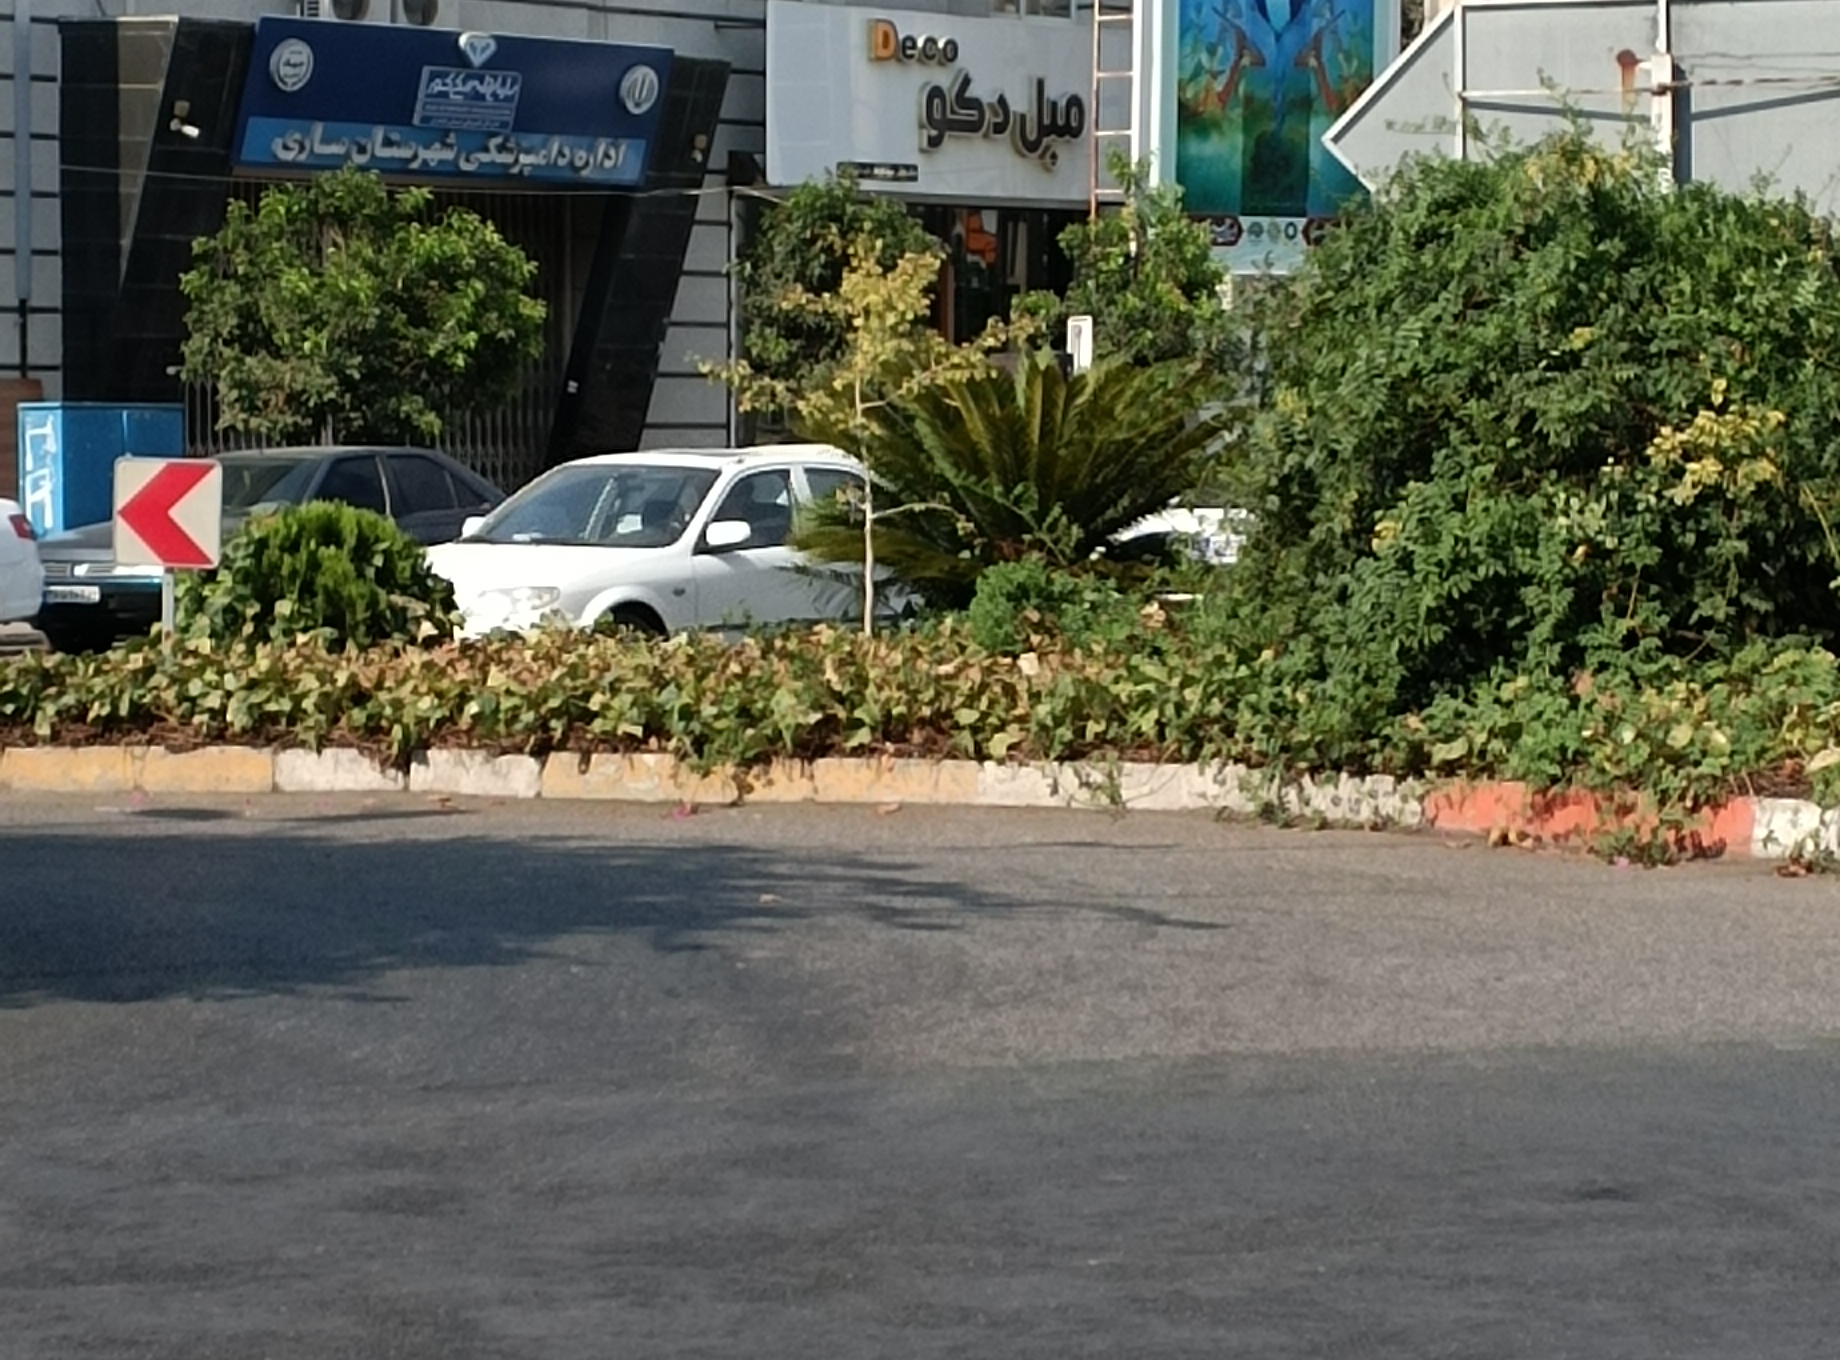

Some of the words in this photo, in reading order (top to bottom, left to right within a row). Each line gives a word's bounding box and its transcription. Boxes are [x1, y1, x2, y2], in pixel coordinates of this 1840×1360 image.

[868, 19, 960, 65] Deco
[920, 69, 1010, 153] دکو
[1012, 76, 1086, 170] مبل
[269, 121, 348, 163] ساری
[349, 124, 458, 170] شهرستان
[458, 134, 571, 176] دامپزشکی
[573, 139, 628, 176] اداره
